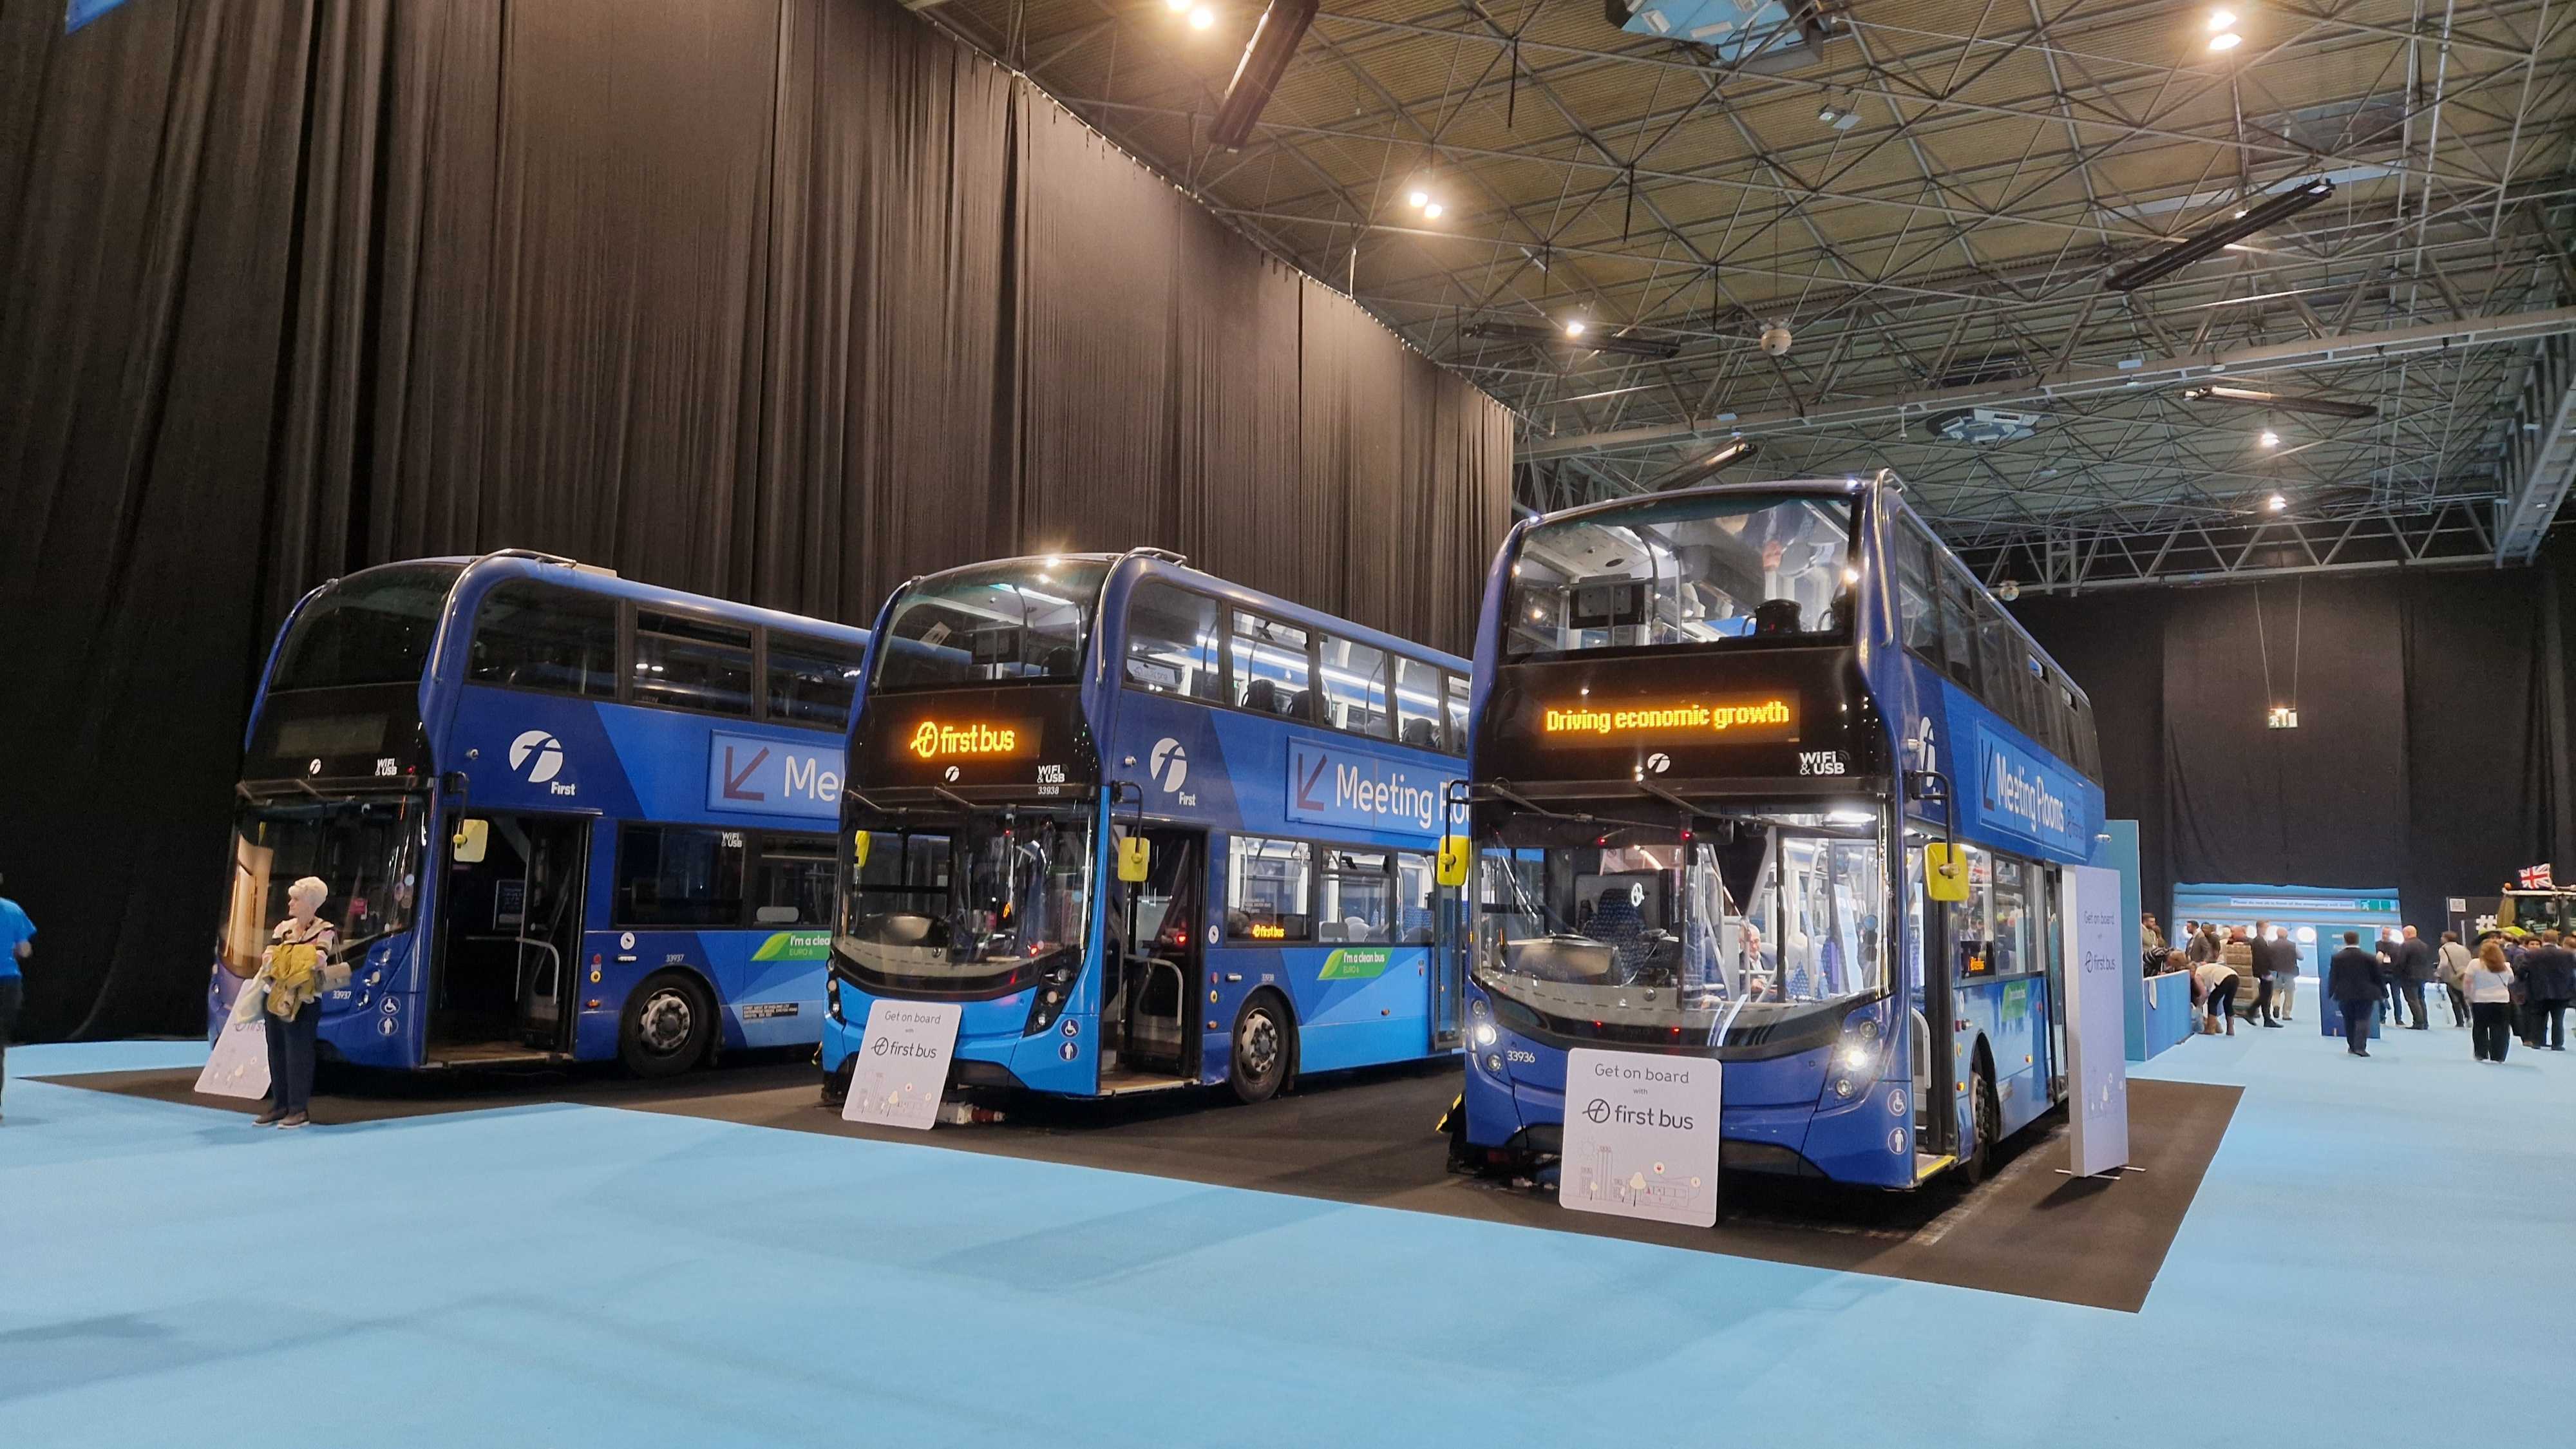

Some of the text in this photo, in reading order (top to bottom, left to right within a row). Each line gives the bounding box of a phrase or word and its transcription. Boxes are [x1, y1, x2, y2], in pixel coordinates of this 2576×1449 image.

[1547, 701, 1790, 734] Driving economic growth
[940, 724, 1015, 753] first bus
[381, 766, 397, 776] USB
[1814, 762, 1845, 775] USB
[784, 755, 844, 802] Me
[1045, 773, 1065, 783] USB
[551, 781, 576, 796] First
[1037, 786, 1059, 795] 33938
[1336, 763, 1470, 829] Meeting Ro
[1997, 752, 2064, 833] Meeting Rooms
[1179, 791, 1196, 806] First
[790, 935, 804, 947] I'm
[805, 938, 811, 946] a
[1343, 951, 1385, 963] I'm a clean bus
[2094, 954, 2105, 971] first
[885, 1010, 941, 1024] Get on board
[890, 1041, 937, 1059] first bus
[1507, 1050, 1535, 1063] 33936
[1595, 1063, 1689, 1084] Get on board
[1615, 1104, 1694, 1130] first bus
